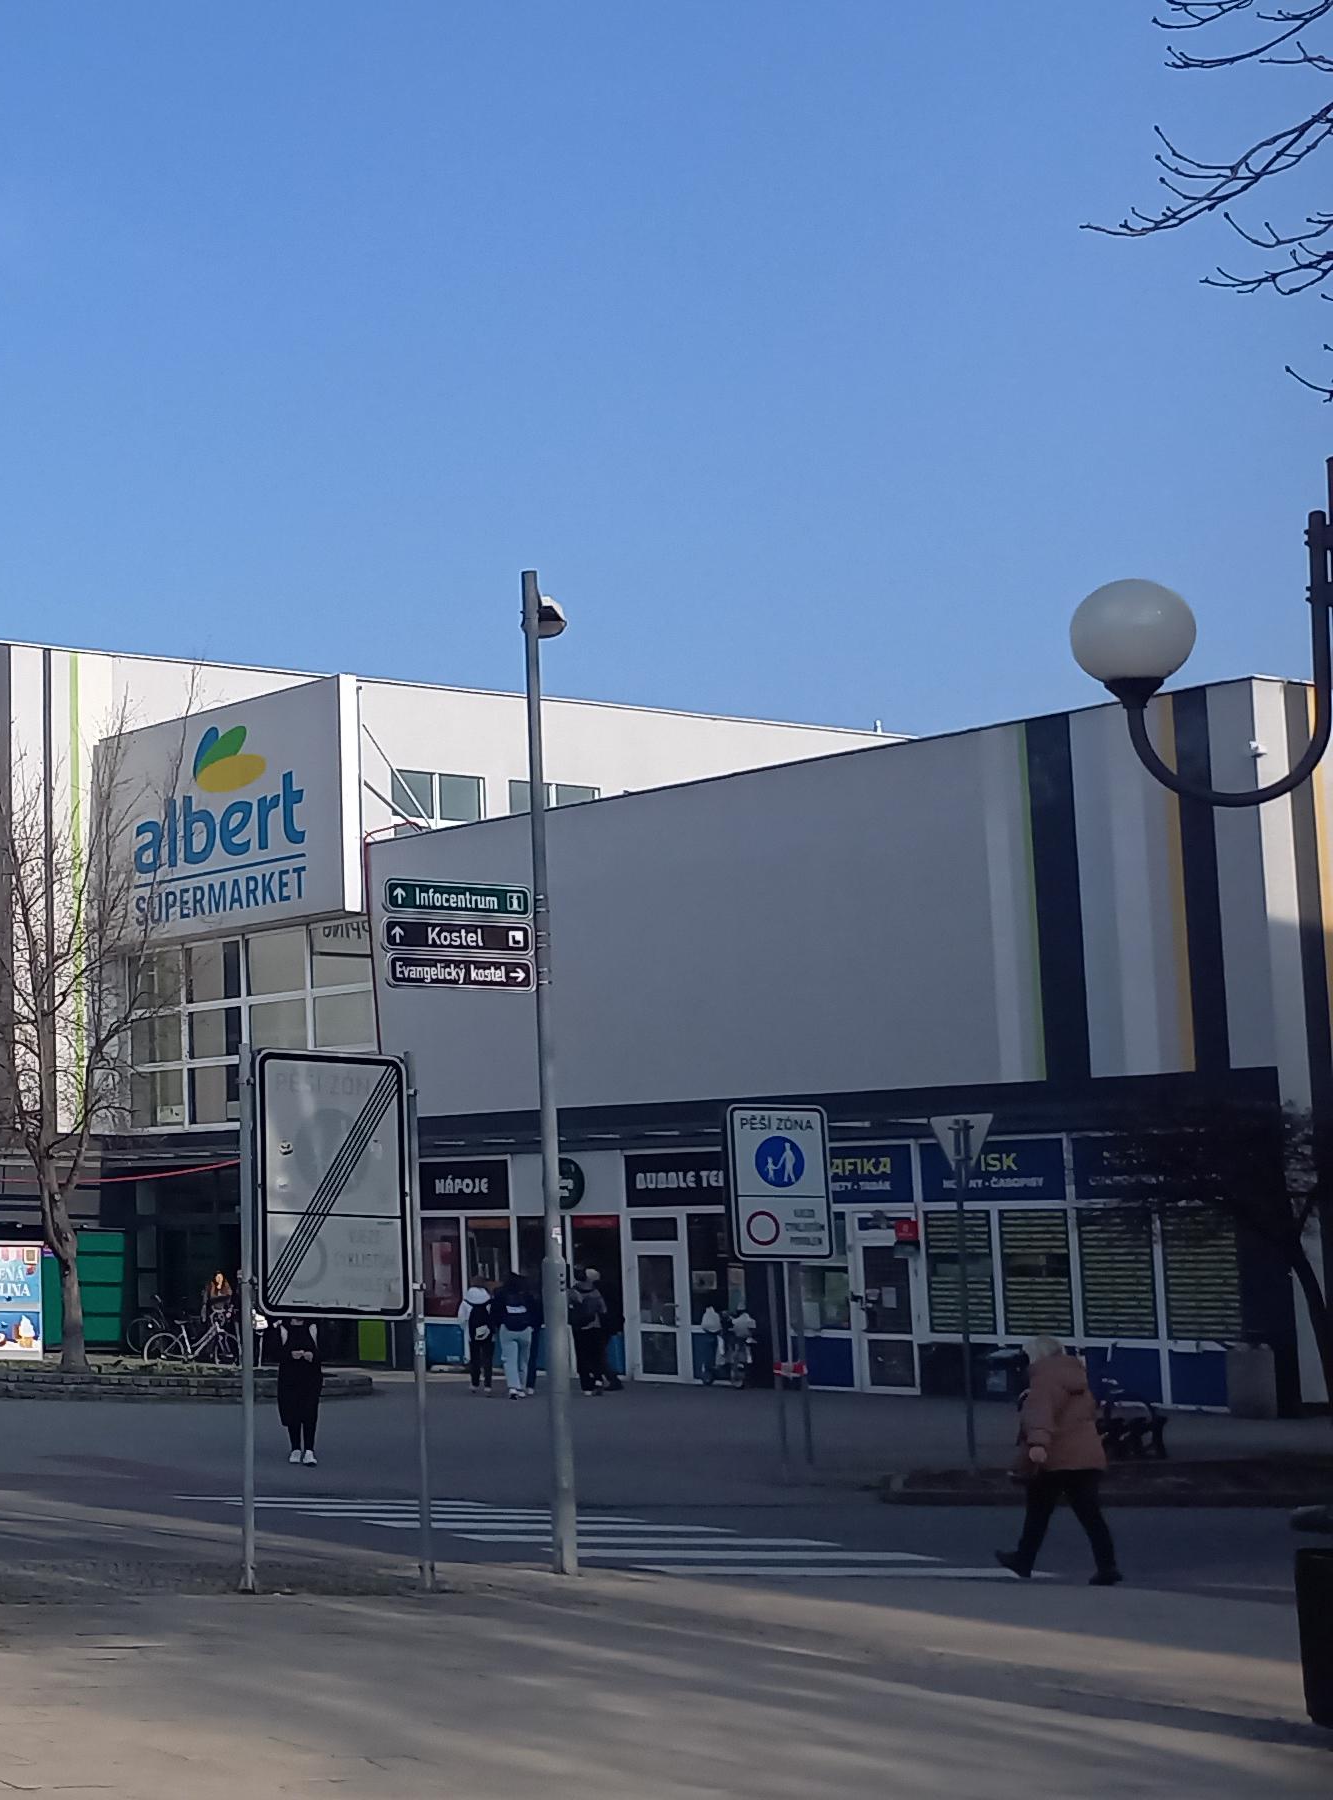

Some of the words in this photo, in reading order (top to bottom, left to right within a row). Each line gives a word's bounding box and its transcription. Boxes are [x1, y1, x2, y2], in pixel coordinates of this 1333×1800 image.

[134, 771, 306, 875] albert
[135, 866, 306, 926] SUPERMARKET
[415, 887, 498, 910] Infocentrum
[427, 926, 484, 947] Kostel
[395, 961, 466, 984] Evangelický
[470, 964, 507, 982] kostel
[740, 1115, 771, 1130] PĚŠÍ
[776, 1116, 814, 1131] ZÓNA
[830, 1156, 892, 1176] AFIKA
[980, 1152, 1019, 1172] ISK
[435, 1174, 489, 1194] NÁPOJE
